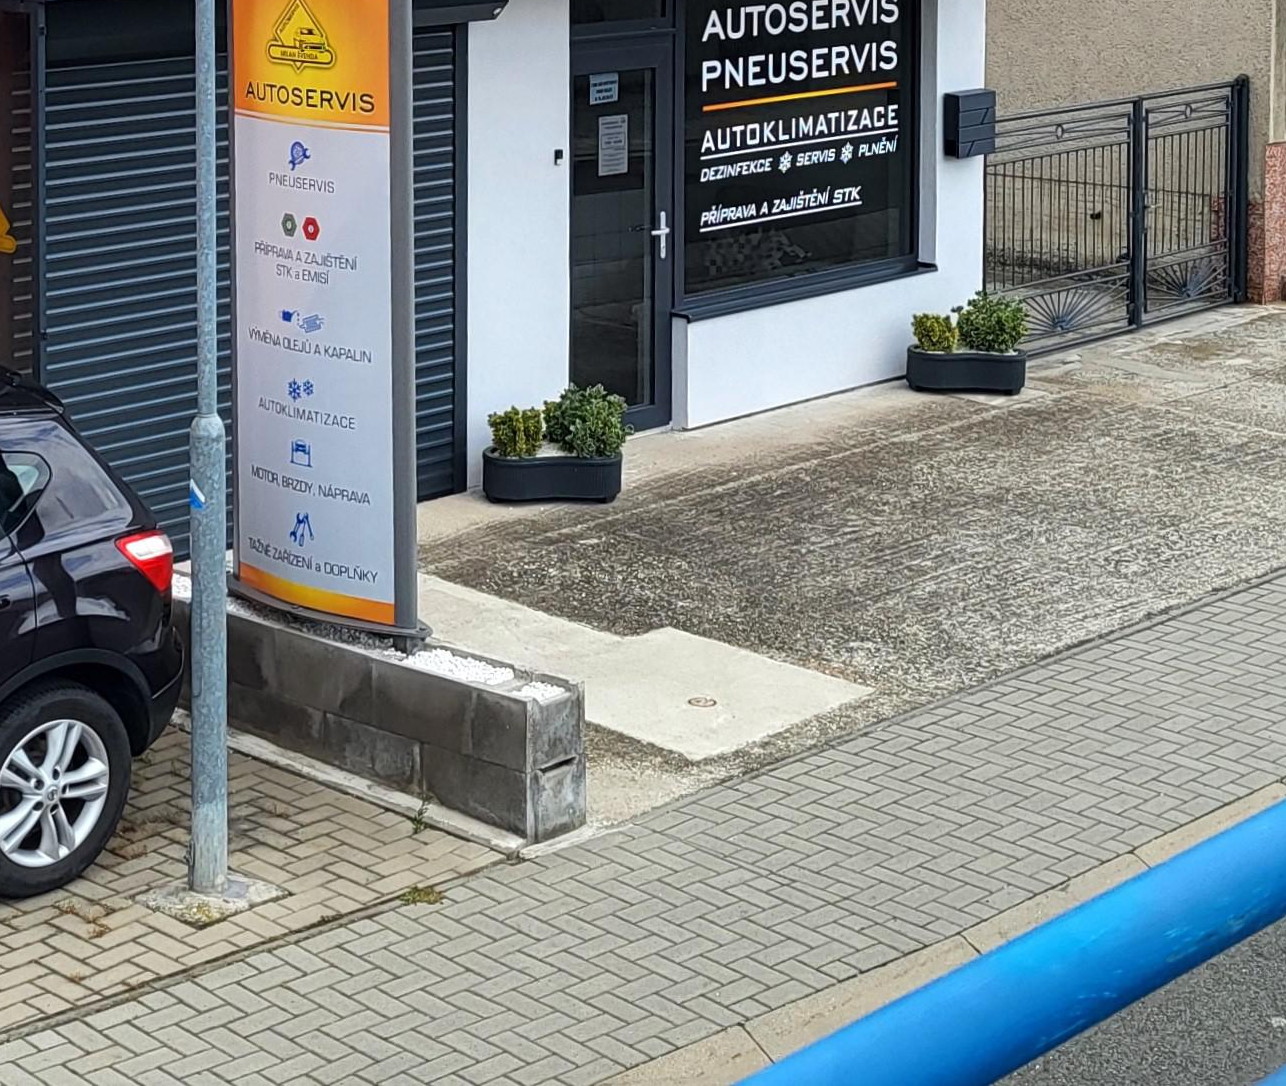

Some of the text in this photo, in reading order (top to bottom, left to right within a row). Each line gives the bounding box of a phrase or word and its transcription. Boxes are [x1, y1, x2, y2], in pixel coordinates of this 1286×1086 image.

[701, 40, 898, 92] PNEUSERVIS
[245, 81, 375, 113] AUTOSERVIS
[700, 104, 899, 154] AUTOKLIMATIZACE
[700, 135, 899, 183] DEZINFEKCE SERVIS PLNĚNÍ
[269, 172, 335, 194] PNEUSERVIS
[700, 186, 862, 226] PŘÍPRAVA A ZAJIŠTĚNÍ STK
[254, 240, 358, 271] PŘÍPRAVA A ZAJIŠTĚNÍ
[276, 263, 330, 285] STK a EMISÍ
[248, 326, 372, 363] VÝMĚNA OLEJŮ A KAPALIN
[258, 396, 356, 430] AUTOKLIMATIZACE
[282, 475, 316, 496] BRZDY,
[318, 484, 371, 505] NÁPRAVA
[248, 537, 378, 584] TAŽNÉ ZAŘÍZENÍ a DOPLŇKY
